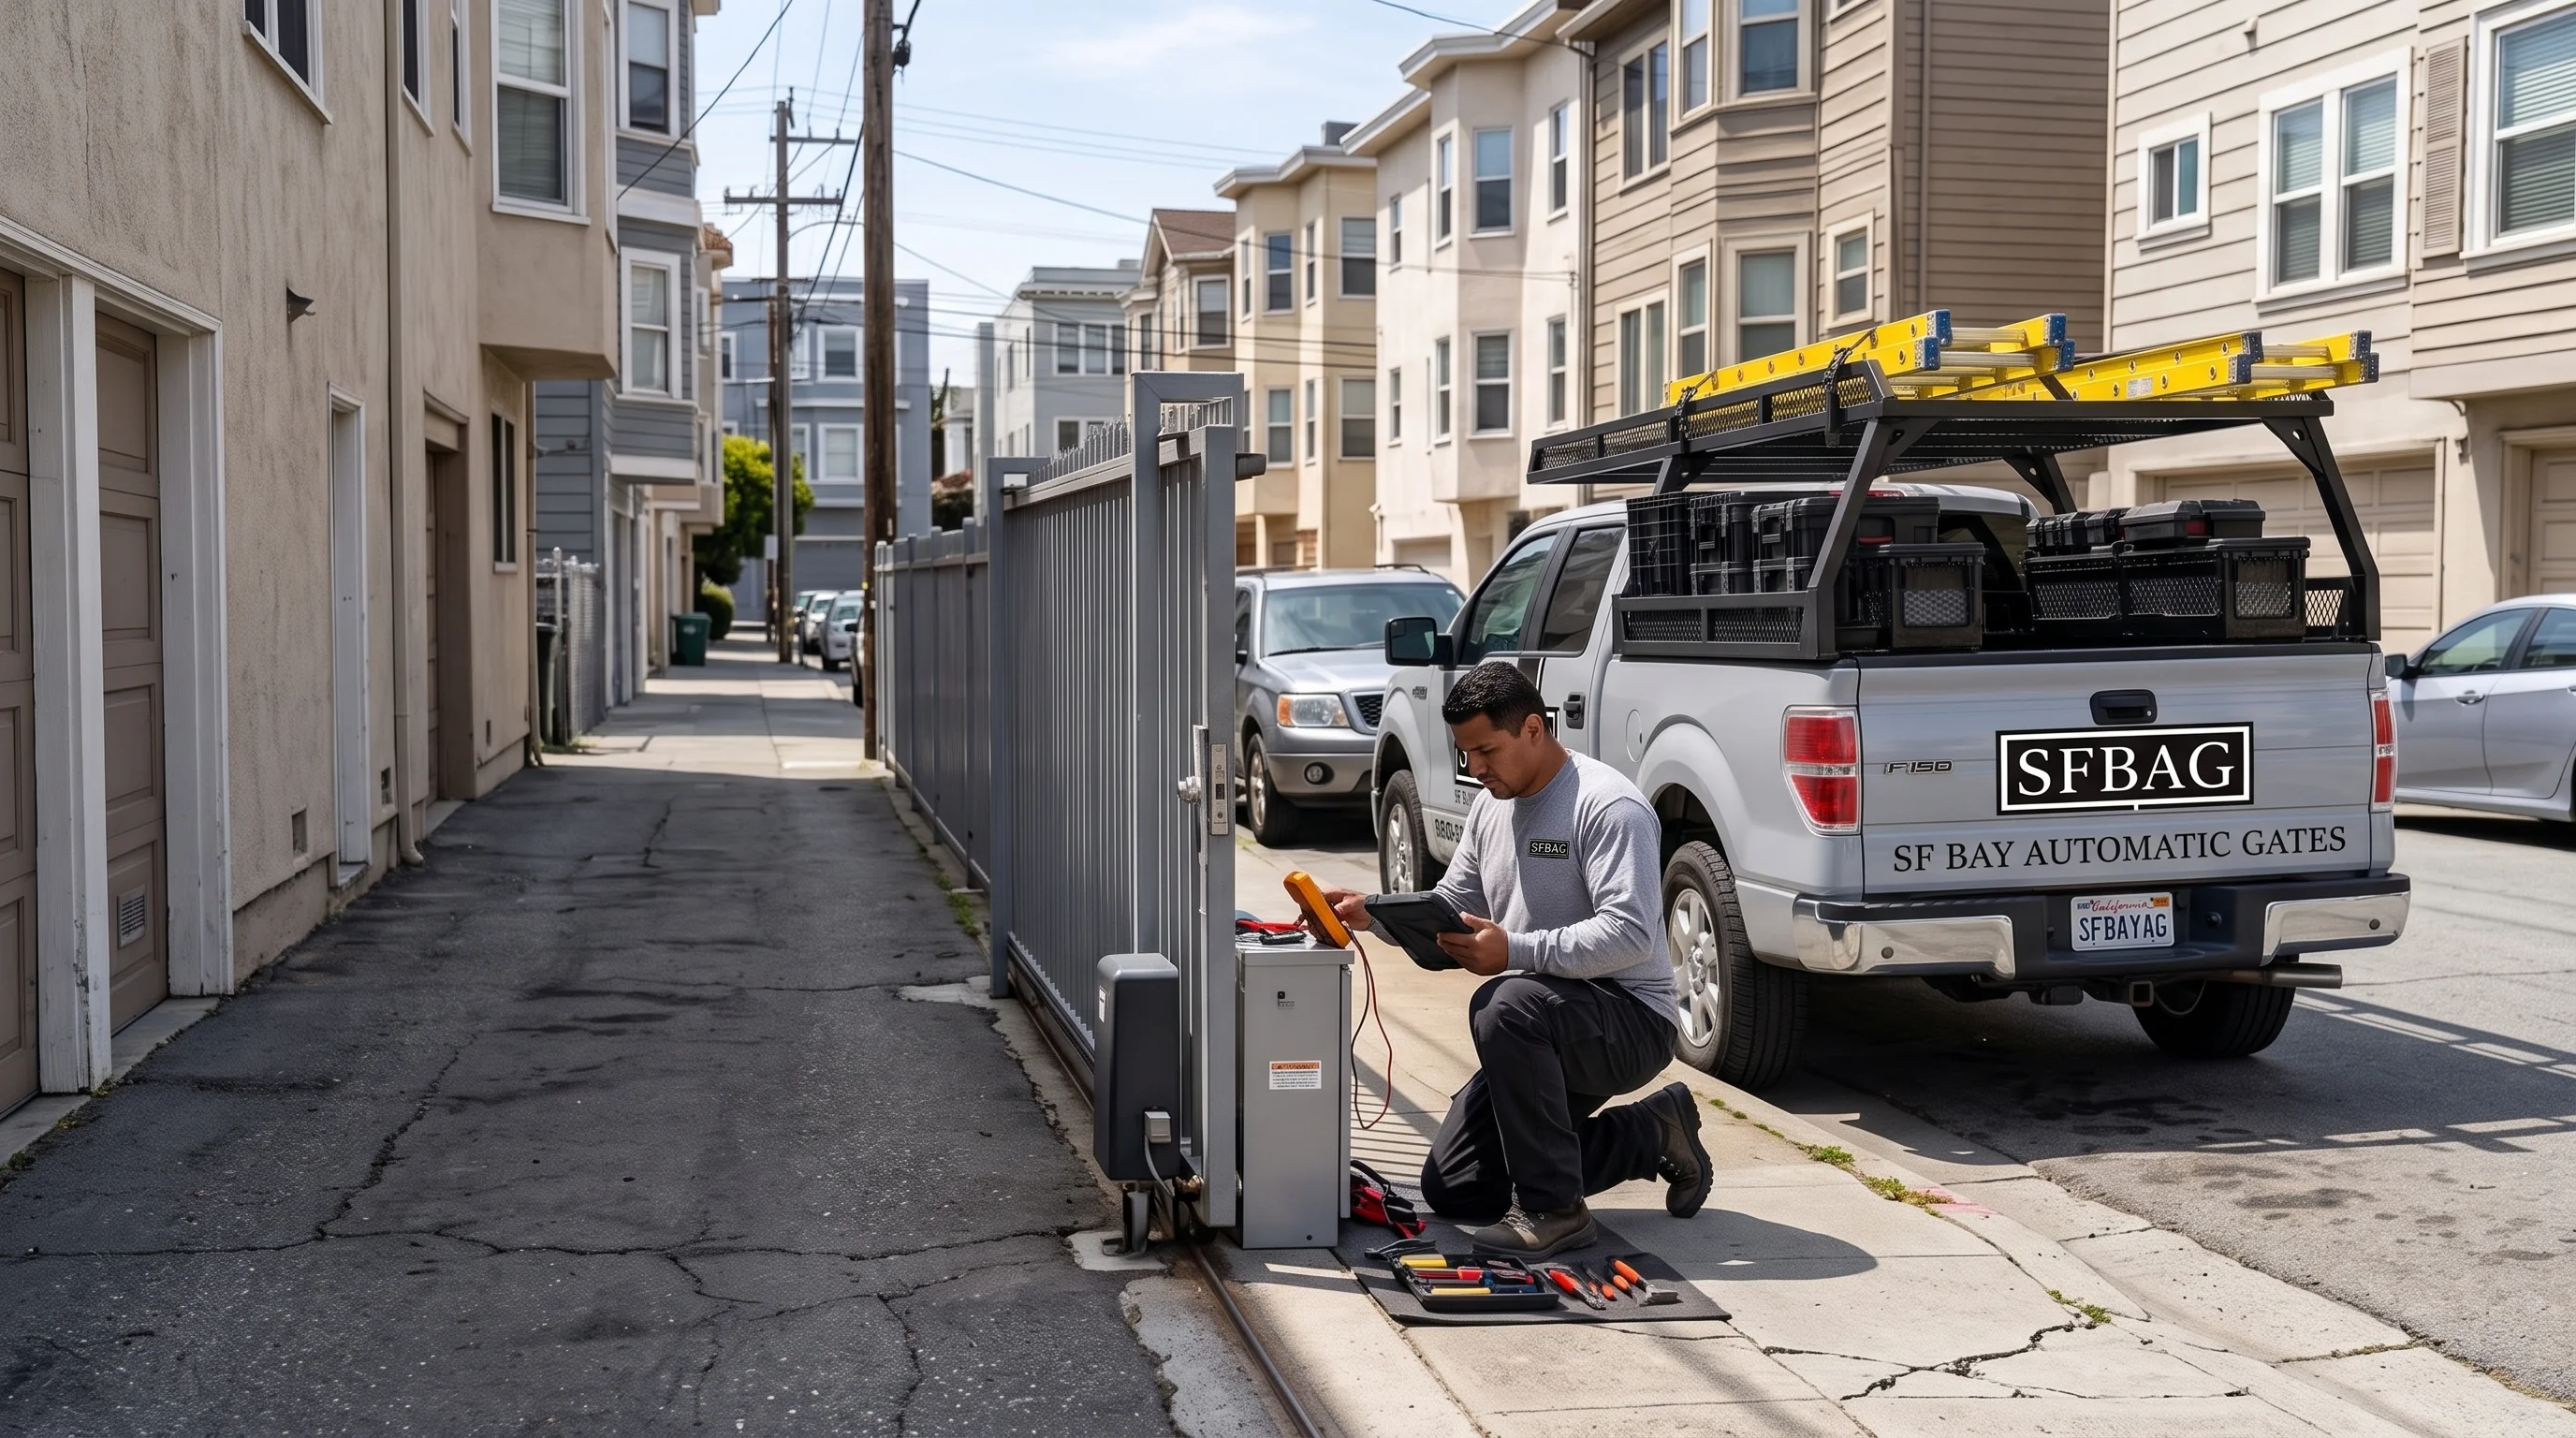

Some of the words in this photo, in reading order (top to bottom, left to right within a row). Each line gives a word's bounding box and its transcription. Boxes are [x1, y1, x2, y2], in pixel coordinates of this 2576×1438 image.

[2018, 741, 2235, 797] SFBAG
[1894, 844, 1936, 873] SF
[1945, 842, 2015, 870] BAY
[2023, 831, 2232, 867] AUTOMATIC
[2242, 826, 2347, 857] GATES
[2078, 914, 2168, 943] SFBAYAG
